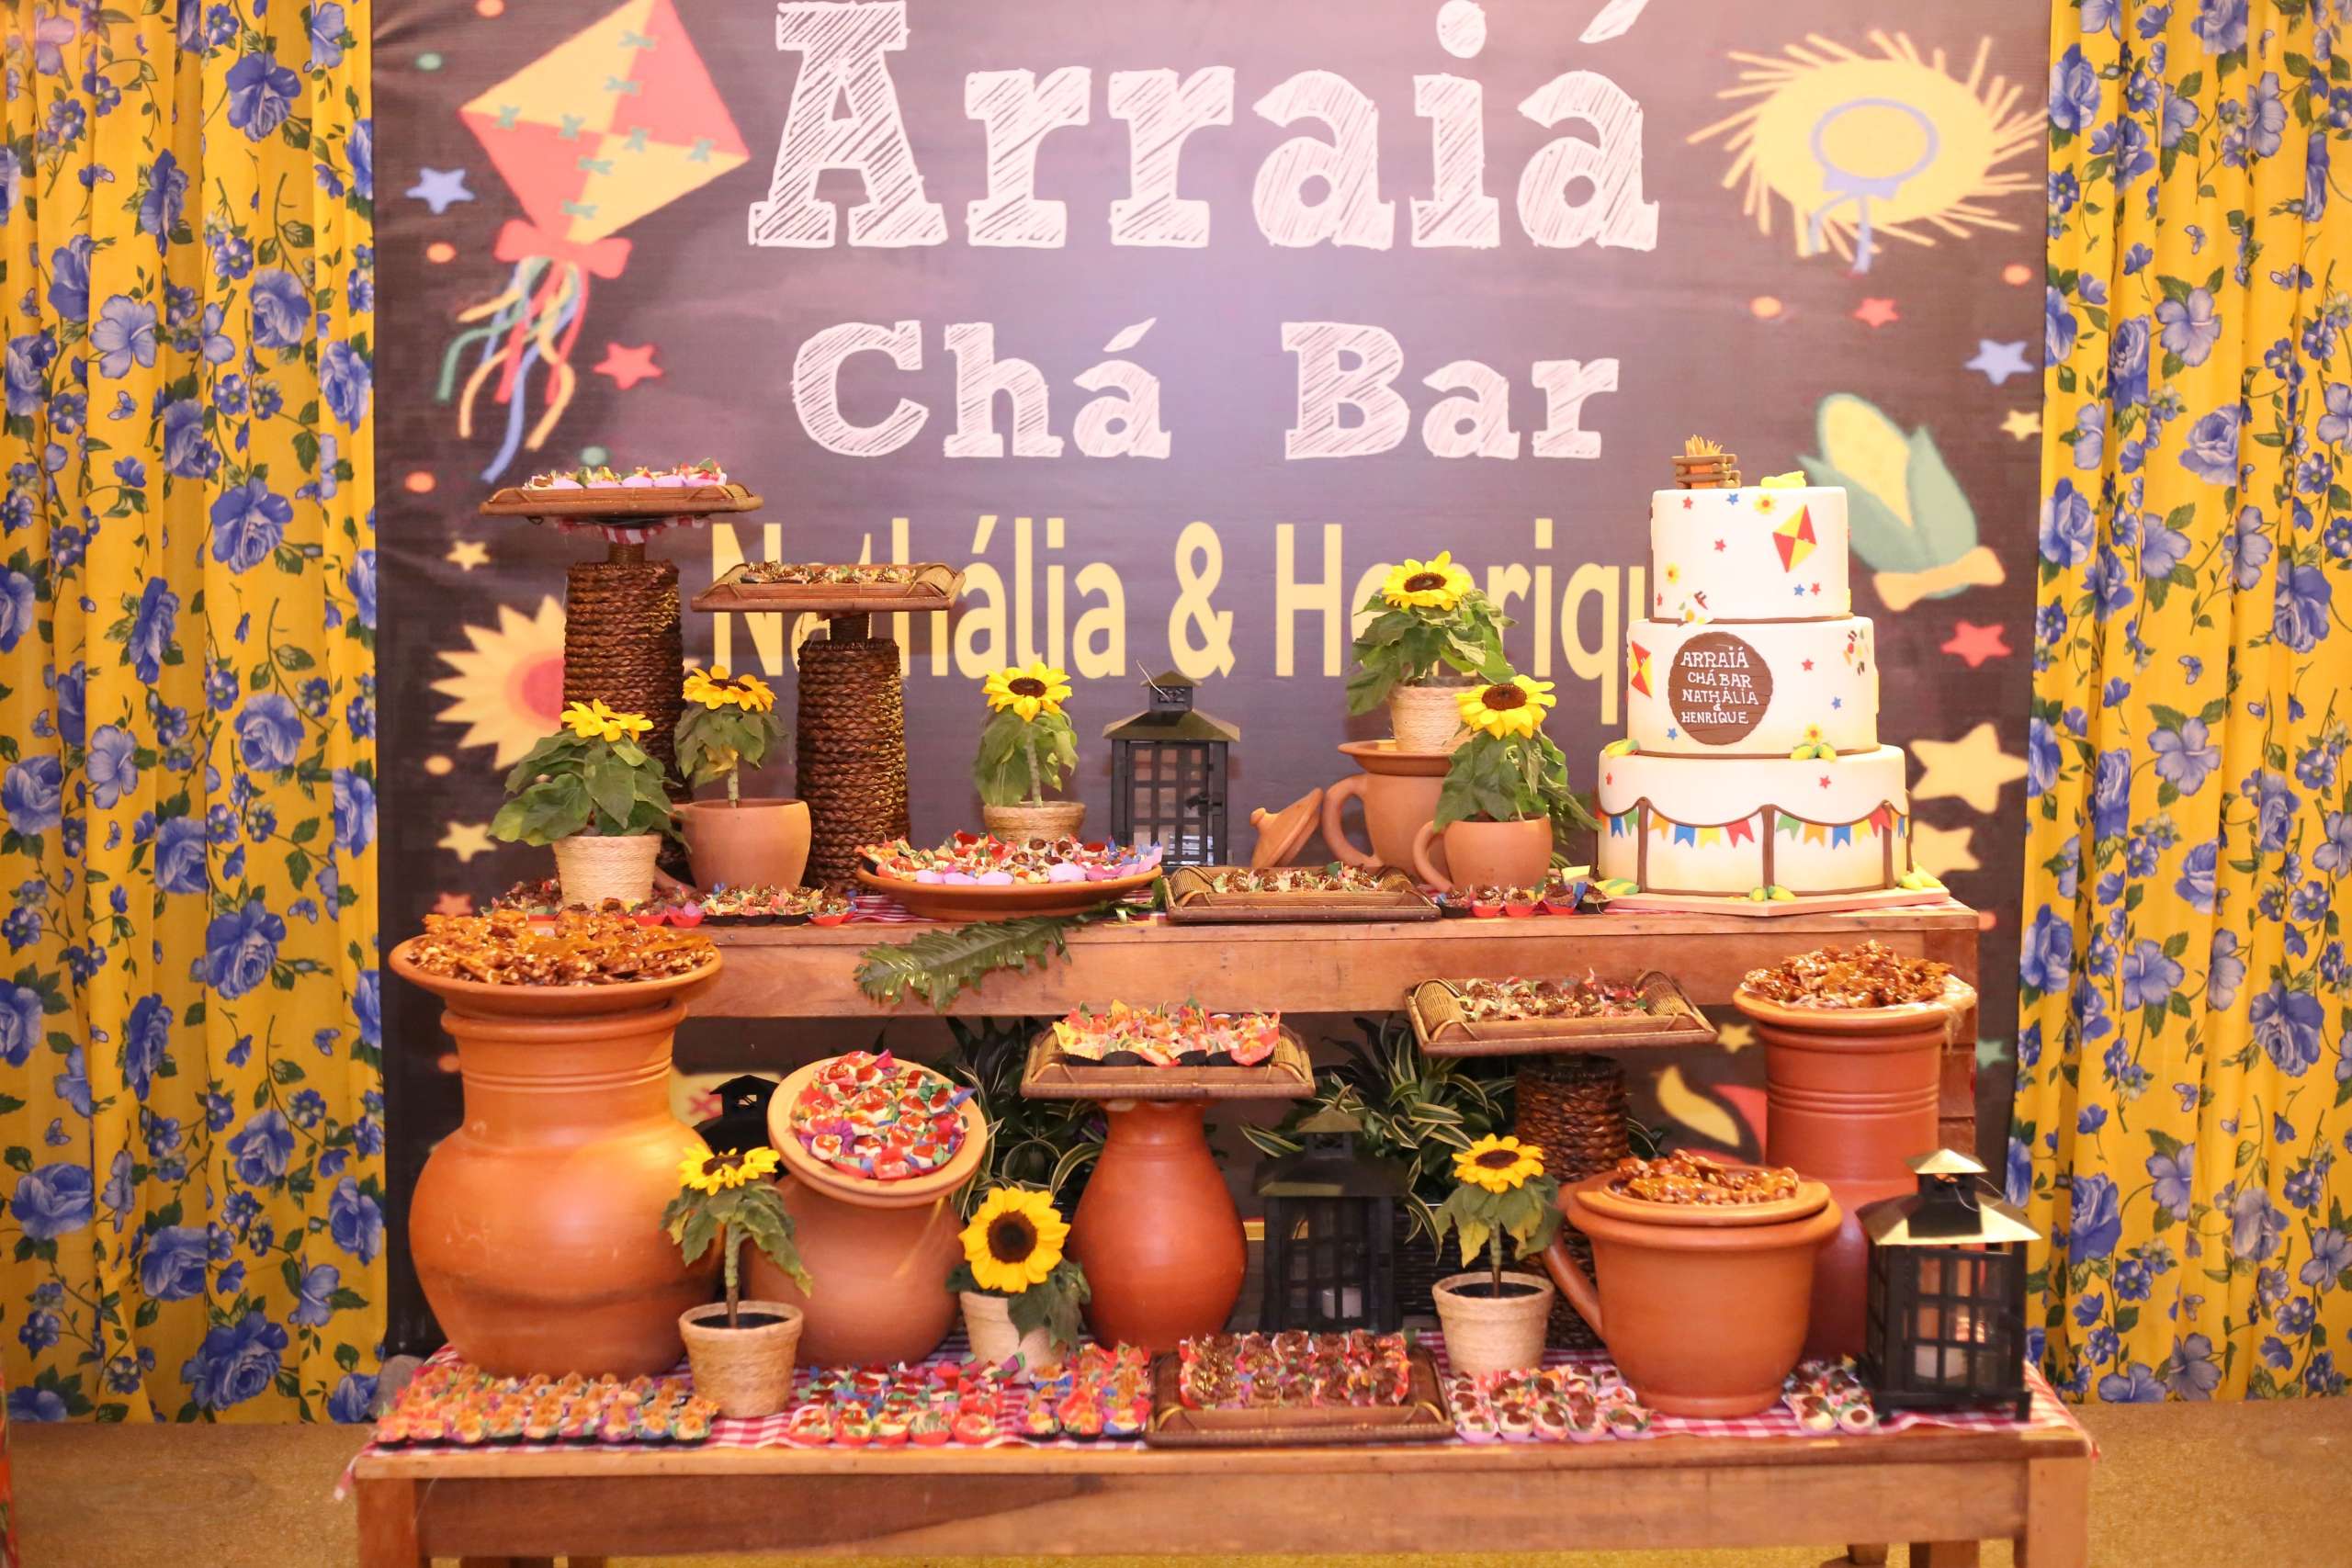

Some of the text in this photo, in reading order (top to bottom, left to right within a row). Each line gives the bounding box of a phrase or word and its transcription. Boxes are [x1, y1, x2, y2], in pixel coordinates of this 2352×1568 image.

[748, 0, 1659, 252] Arraiá
[792, 317, 1620, 459] Chá Bar
[711, 514, 1126, 680] Nhália
[1172, 520, 1235, 678] &
[1680, 711, 1749, 724] HENRIQUE
[1687, 669, 1753, 688] CHÁ BAR
